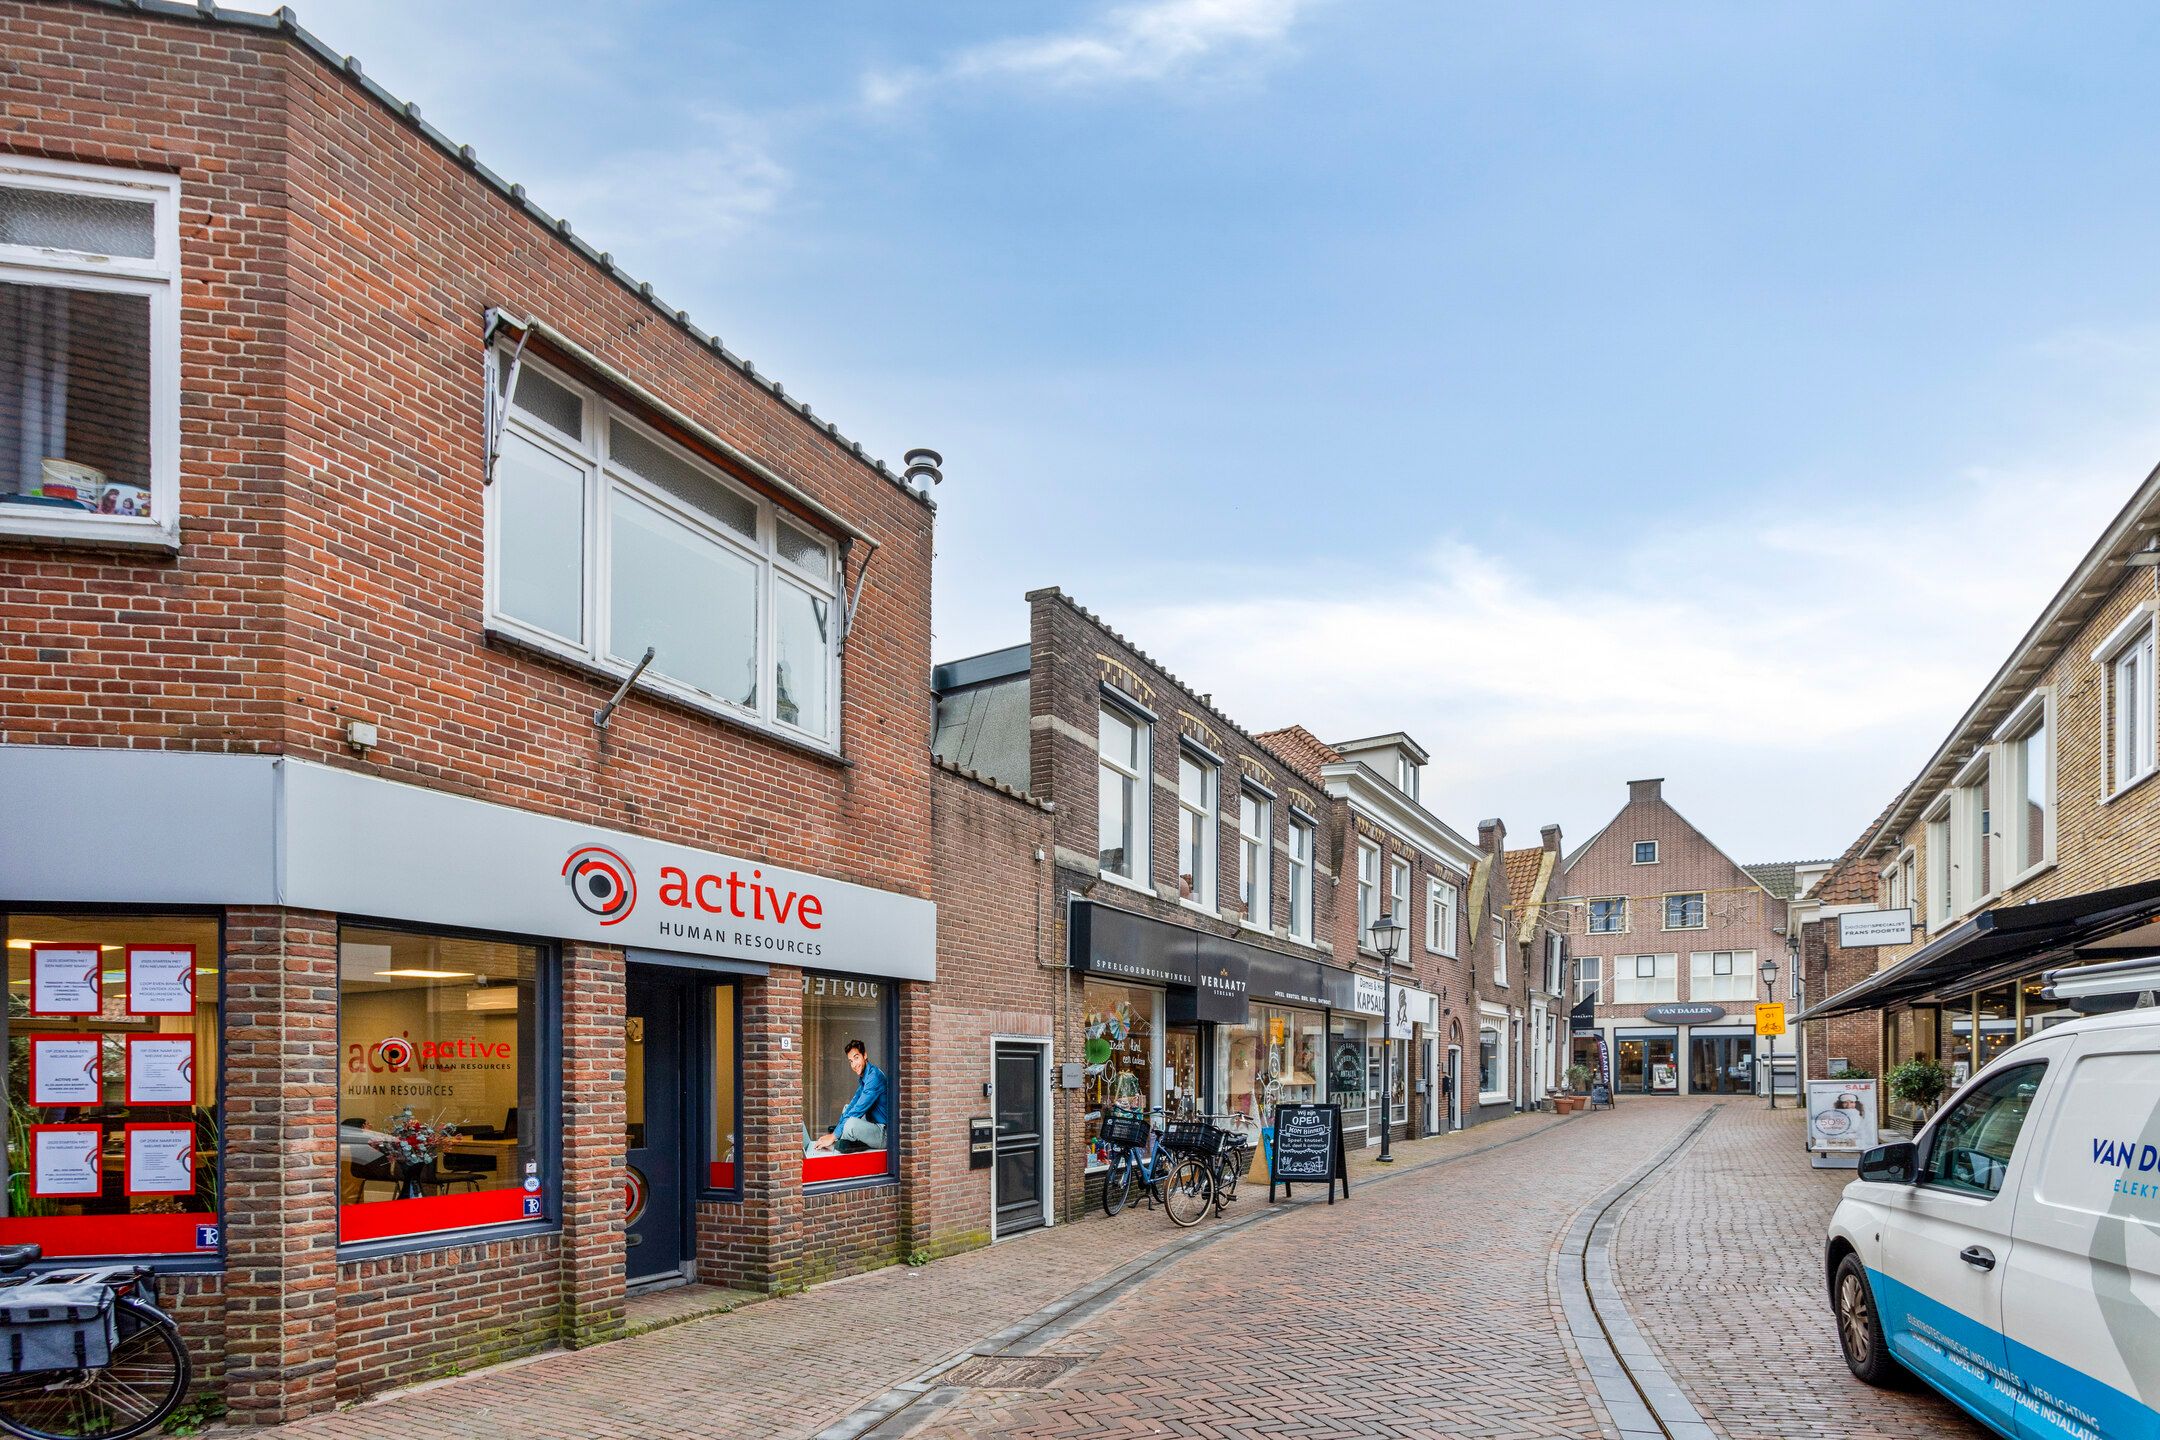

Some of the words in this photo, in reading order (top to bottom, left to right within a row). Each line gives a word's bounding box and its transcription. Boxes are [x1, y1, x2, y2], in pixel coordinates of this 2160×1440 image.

[659, 866, 823, 929] active
[660, 921, 725, 943] HUMAN
[734, 932, 822, 956] RESOURCES
[1096, 959, 1192, 983] SPEELGOEDRUILWINKEL
[1201, 974, 1246, 992] VERLAAT7
[1357, 991, 1385, 1013] KAPSALO
[422, 1036, 512, 1059] active
[348, 1085, 385, 1096] HUMAN
[391, 1085, 454, 1097] RESOURCES
[2093, 1138, 2136, 1170] VAN
[2138, 1144, 2160, 1173] D
[2113, 1179, 2159, 1199] ELEKT
[1970, 1349, 2021, 1387] INSTALLATIES
[1994, 1377, 2040, 1415] DUURZAME
[2040, 1404, 2102, 1440] INSTALLATIE
